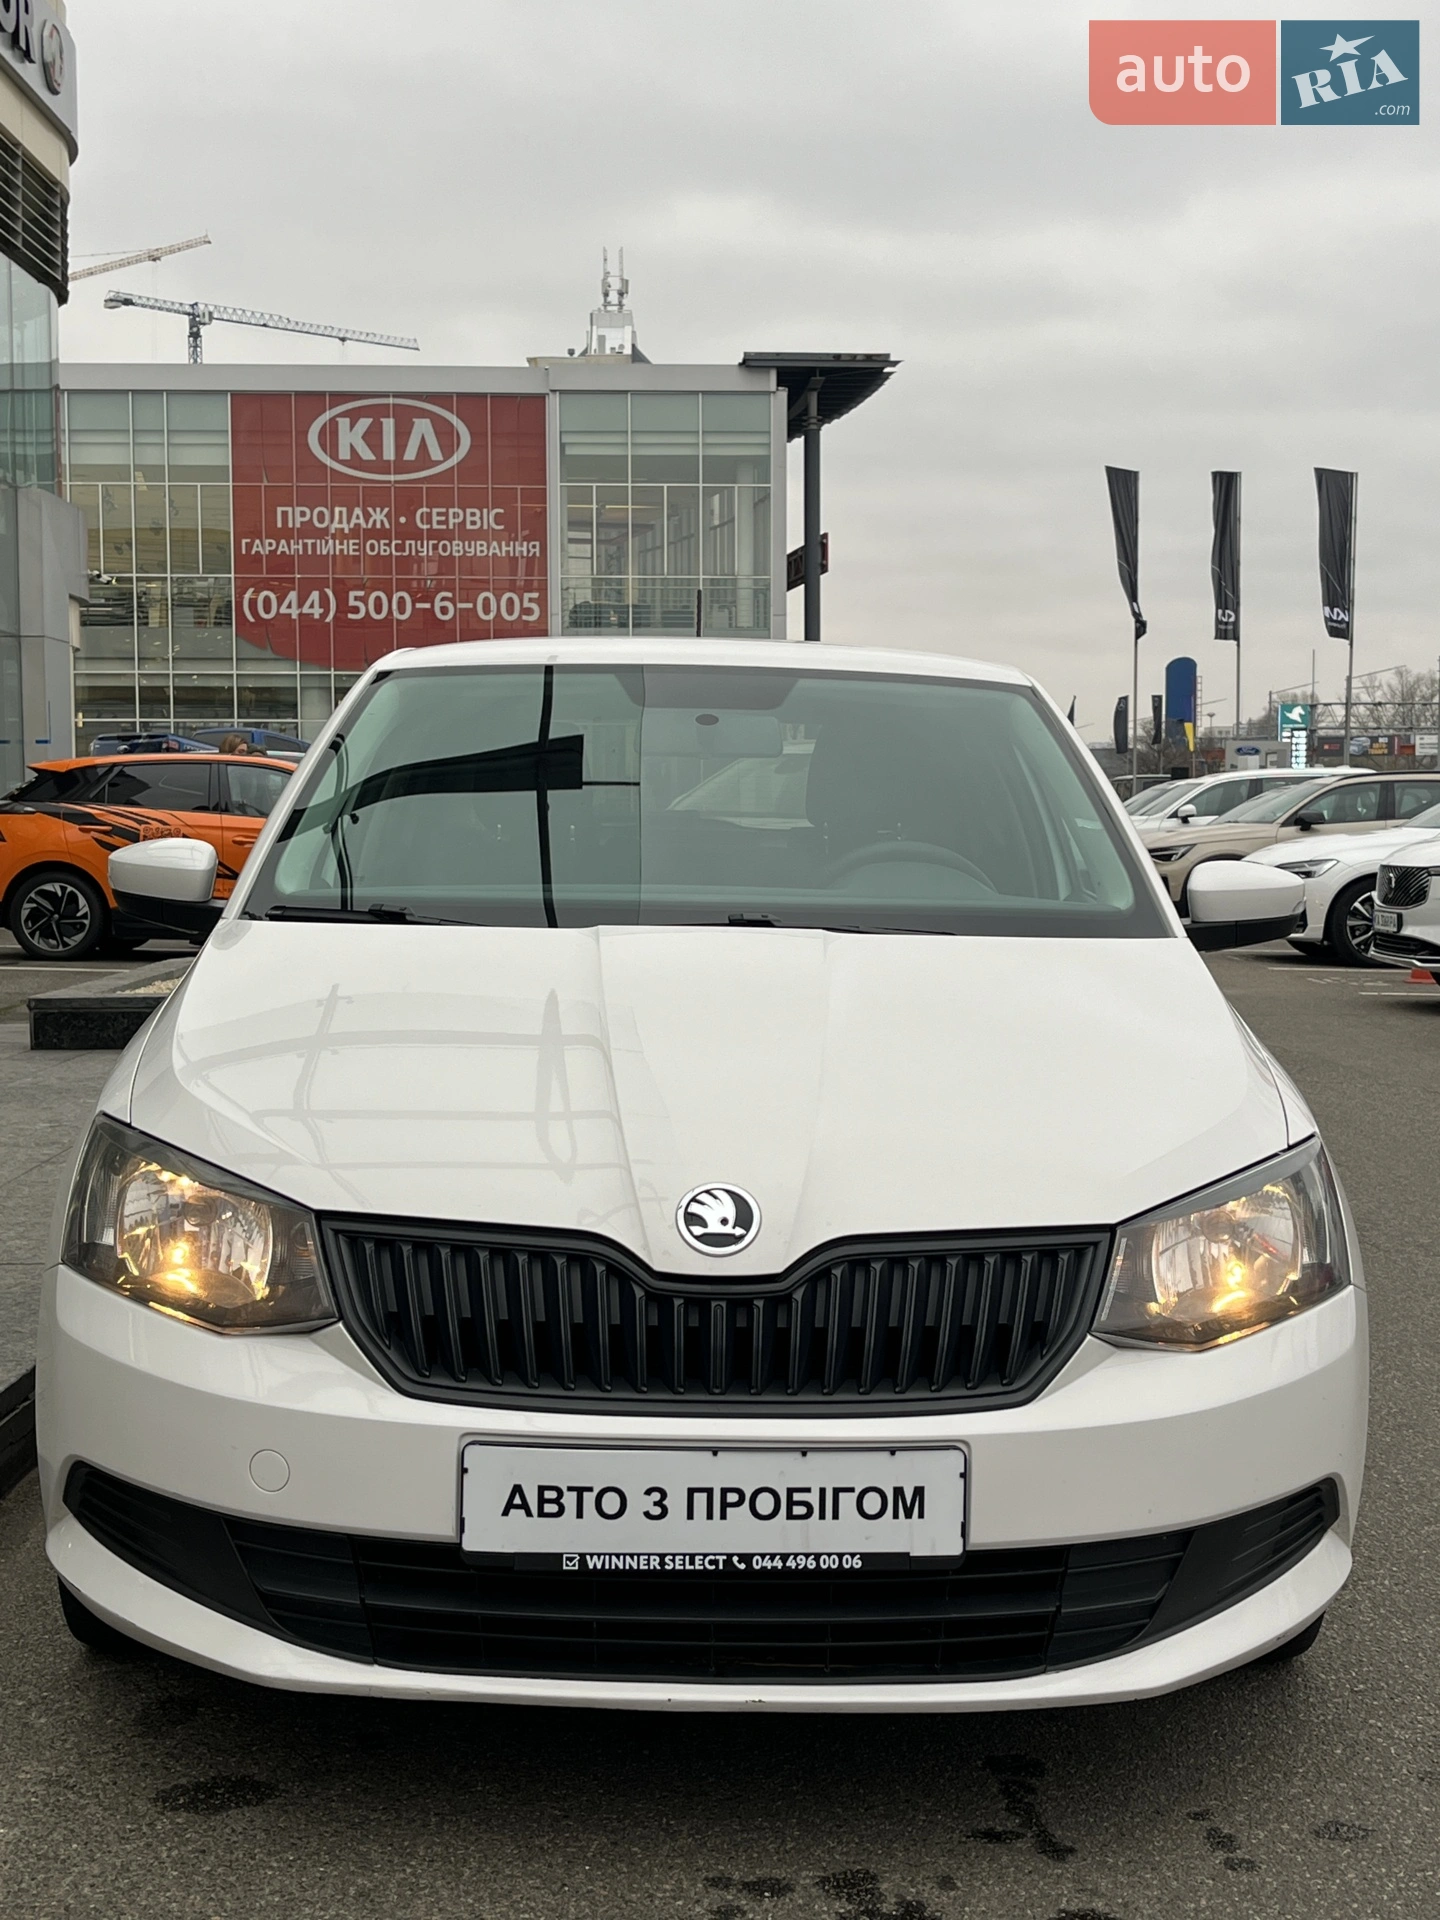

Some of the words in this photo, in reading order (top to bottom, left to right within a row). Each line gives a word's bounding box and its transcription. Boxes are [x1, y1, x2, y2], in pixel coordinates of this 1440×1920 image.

[336, 417, 444, 461] KIA
[276, 506, 391, 533] ПРОДАЖ
[415, 507, 505, 530] СЕРВІС
[241, 535, 360, 556] ГАРАНТІЙНЕ
[365, 539, 541, 557] ОБСЛУГОВУВАННЯ
[242, 587, 337, 623] (044)
[347, 590, 541, 623] 500-6-005
[501, 1484, 628, 1520] АВТО
[642, 1485, 669, 1521] З
[686, 1485, 926, 1521] ПРОБІГОМ
[585, 1554, 661, 1570] WINNER
[664, 1555, 727, 1570] SELECT
[752, 1555, 783, 1570] 044
[785, 1555, 816, 1570] 496
[819, 1555, 840, 1570] 00
[842, 1555, 862, 1570] 06
